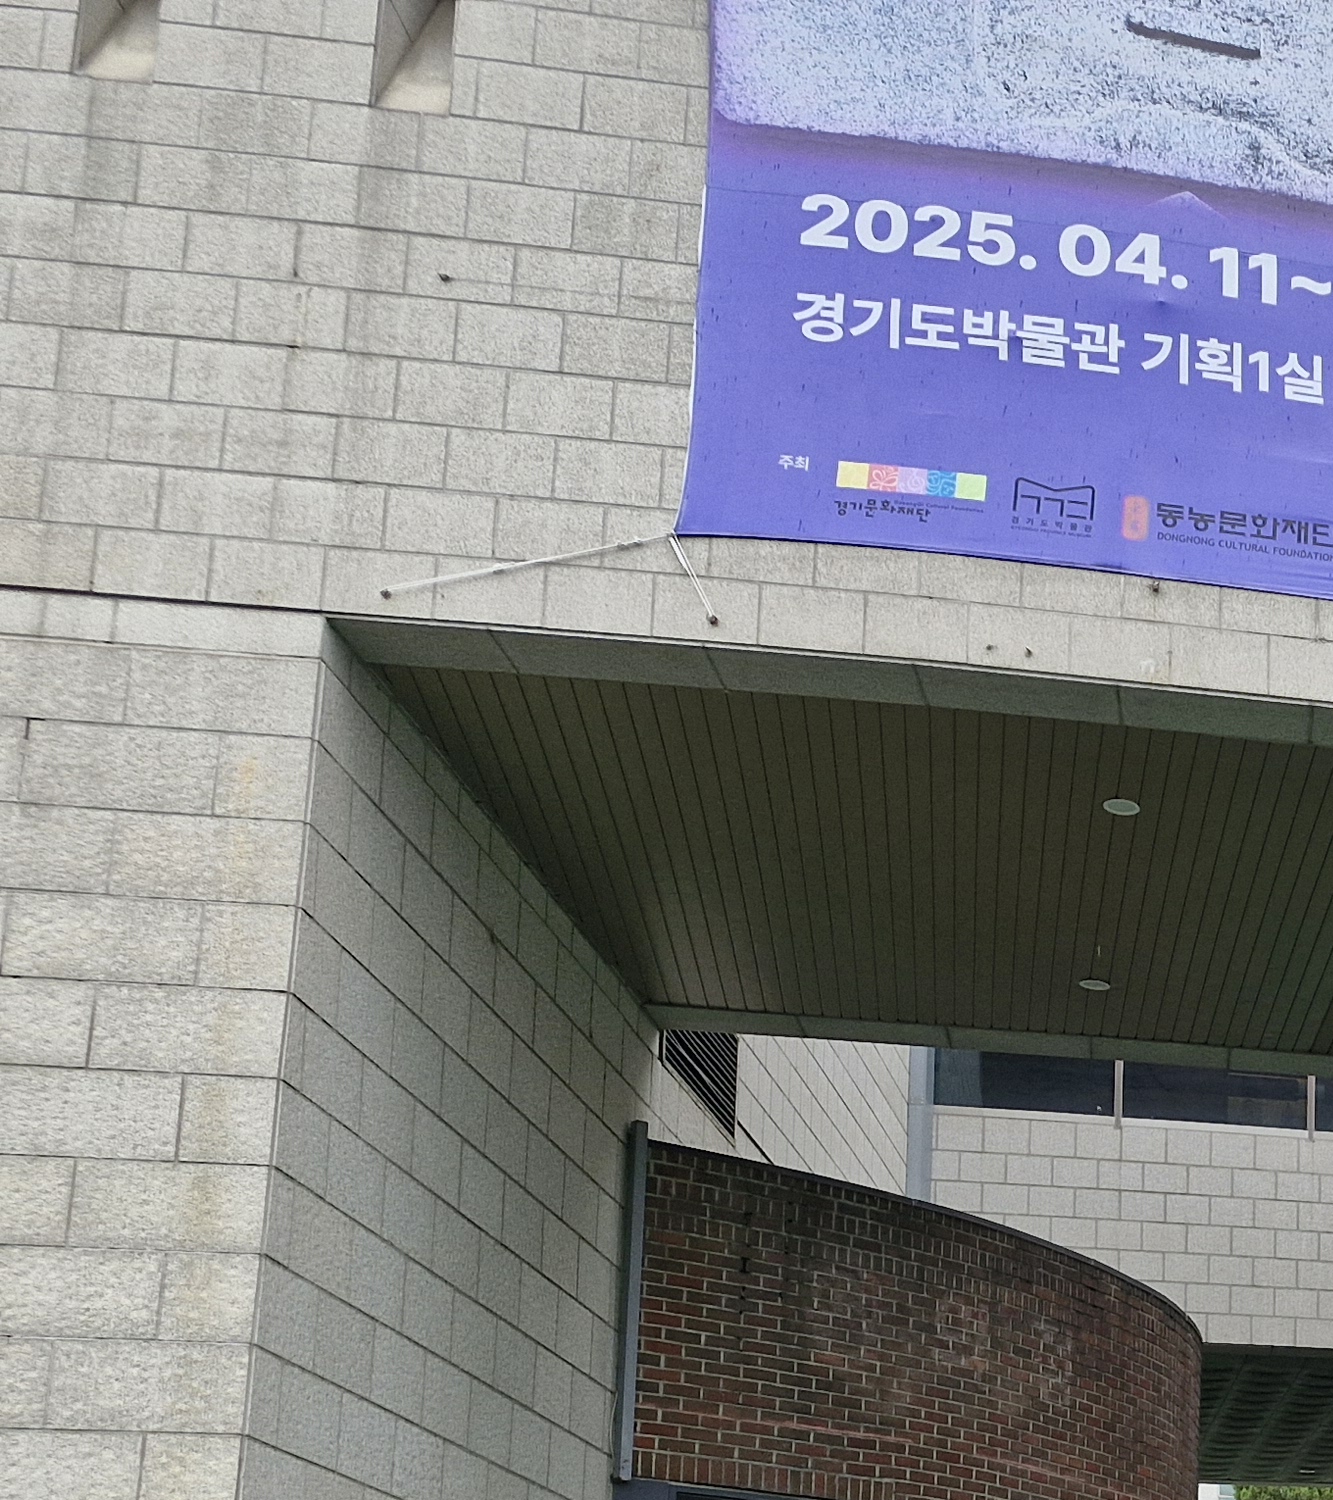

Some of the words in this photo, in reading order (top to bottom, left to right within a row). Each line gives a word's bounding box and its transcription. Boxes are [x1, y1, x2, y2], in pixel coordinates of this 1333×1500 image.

[799, 194, 1037, 270] 2025.
[1058, 223, 1189, 290] 04.
[792, 291, 1124, 375] 경기도박물관
[1140, 331, 1325, 405] 기획1실
[778, 454, 809, 471] 주최
[834, 498, 931, 523] 경기문화재단
[1157, 532, 1215, 547] DONGNONG
[1218, 539, 1269, 554] CULTURAL
